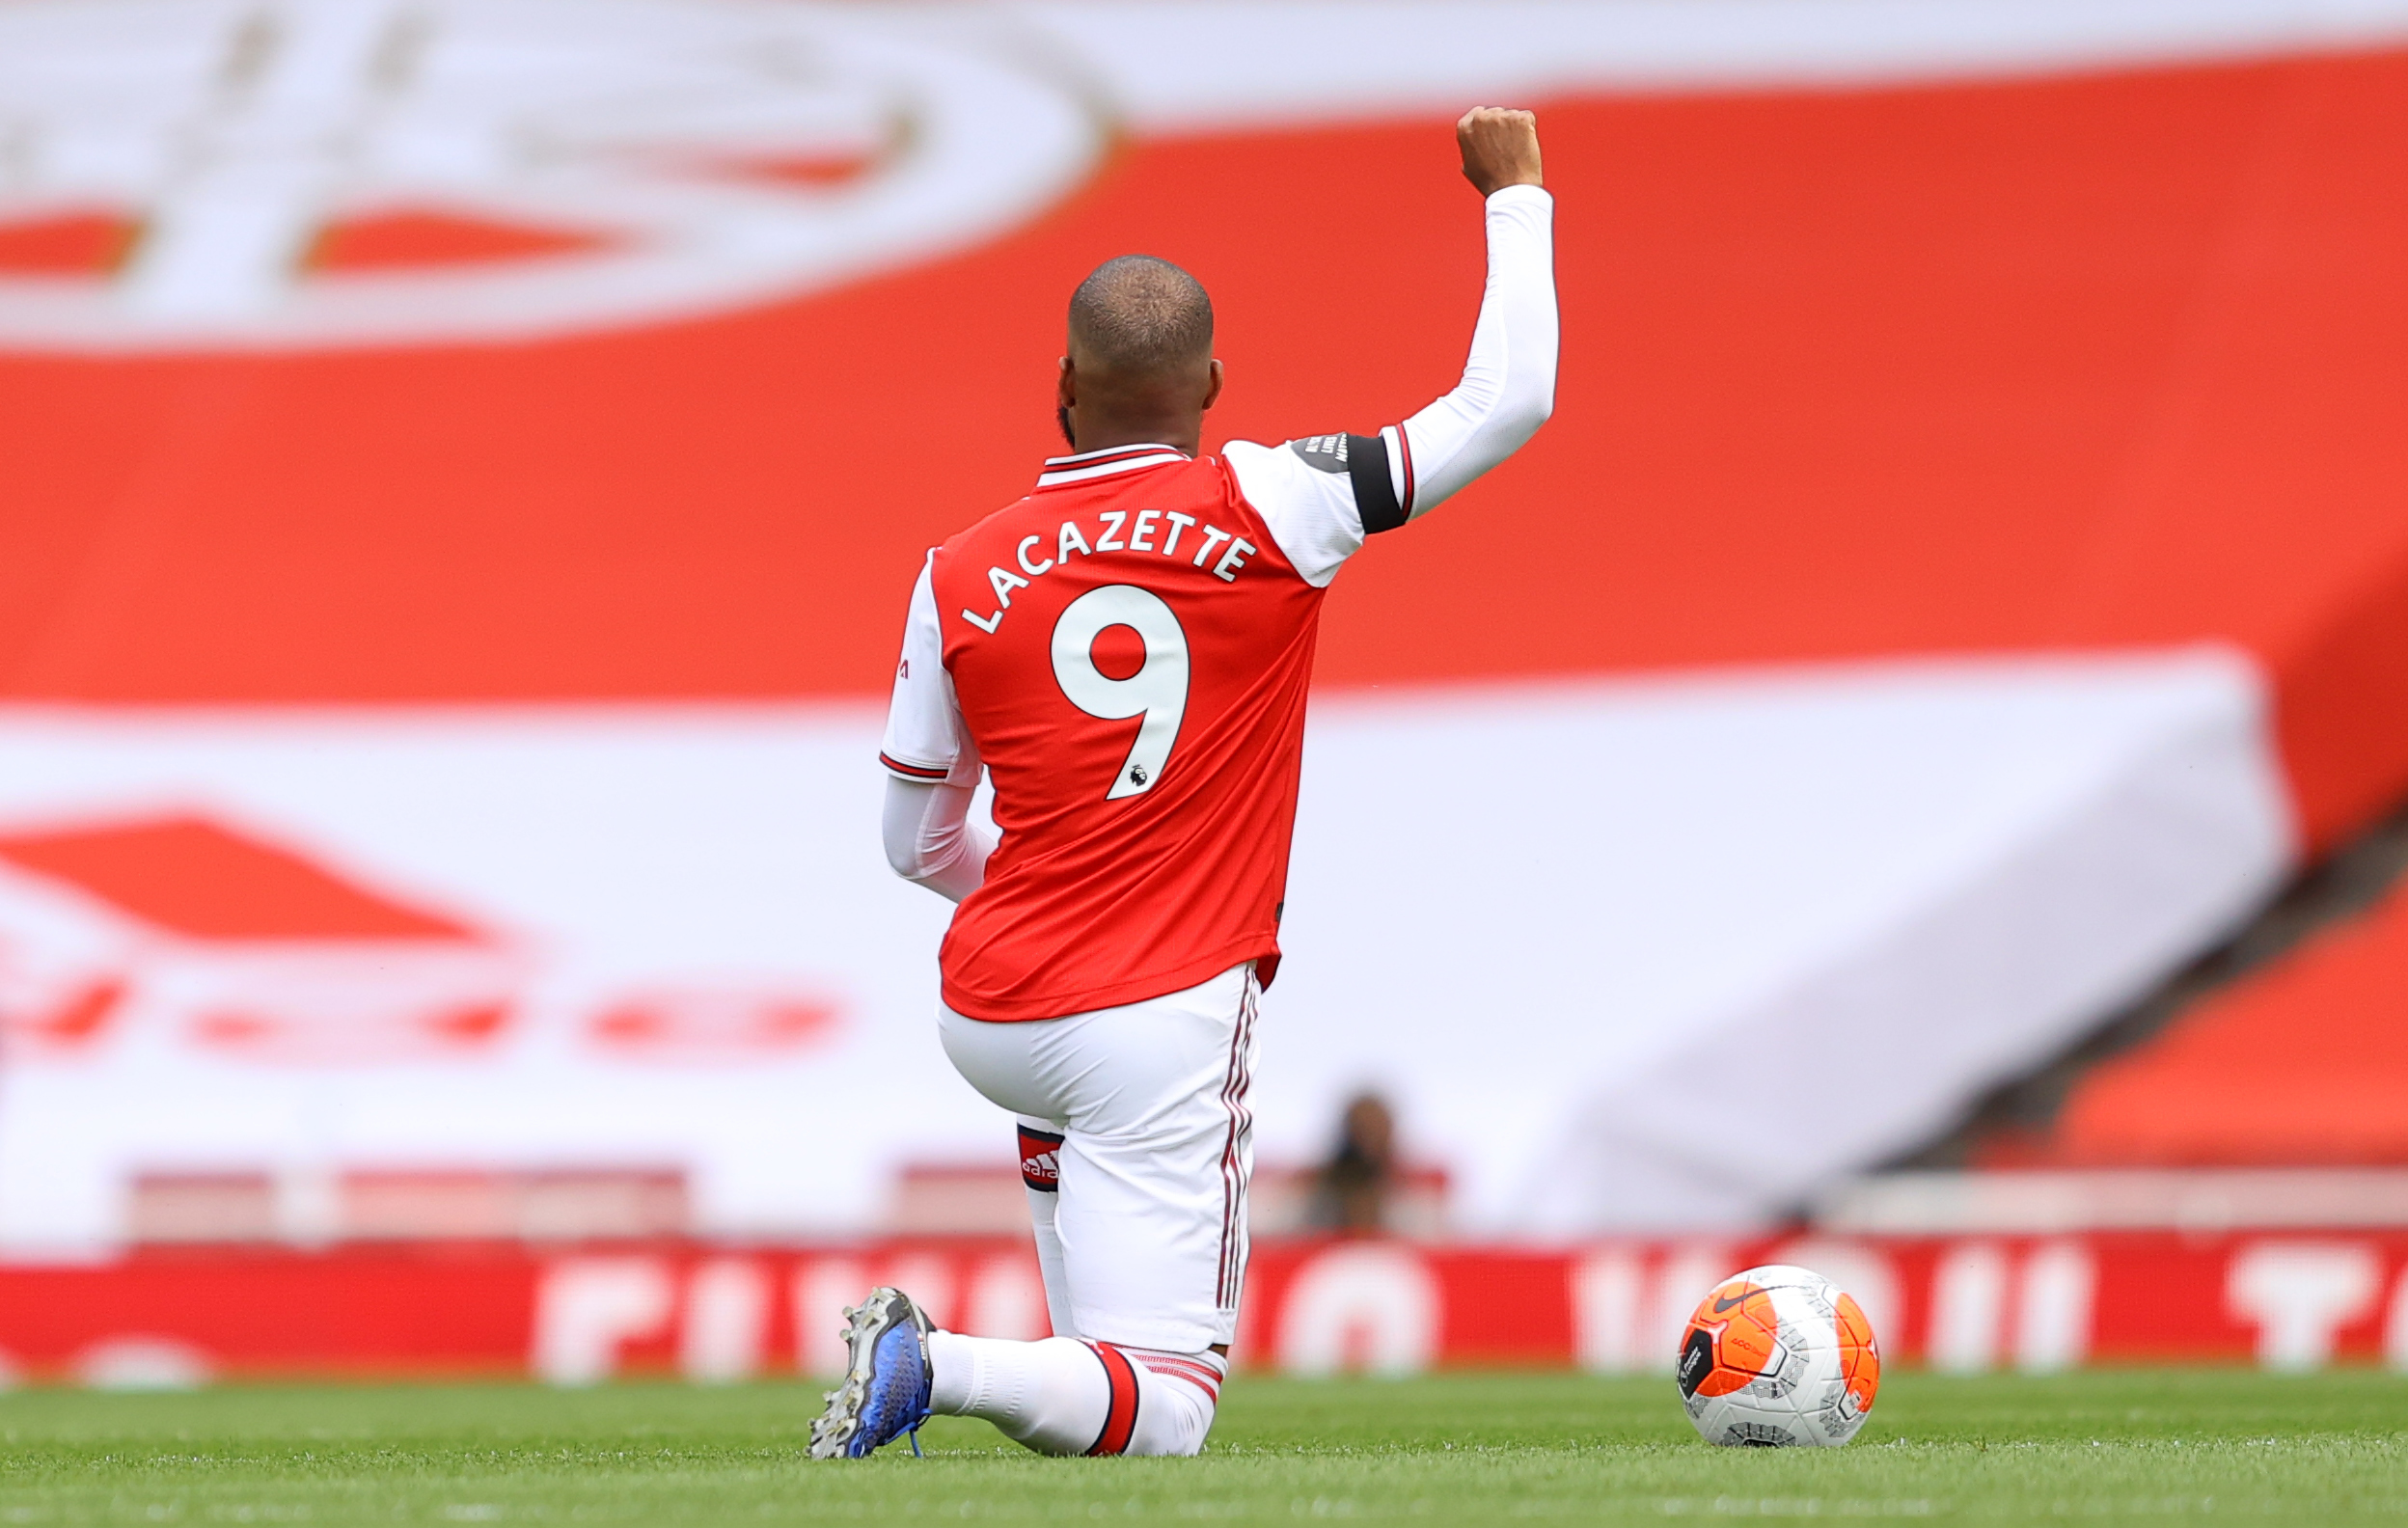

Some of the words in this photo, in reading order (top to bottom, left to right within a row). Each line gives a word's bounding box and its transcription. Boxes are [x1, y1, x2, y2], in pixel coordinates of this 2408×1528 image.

[962, 510, 1256, 635] LACAZETTE
[1050, 584, 1191, 801] 9
[1022, 1162, 1059, 1179] adida
